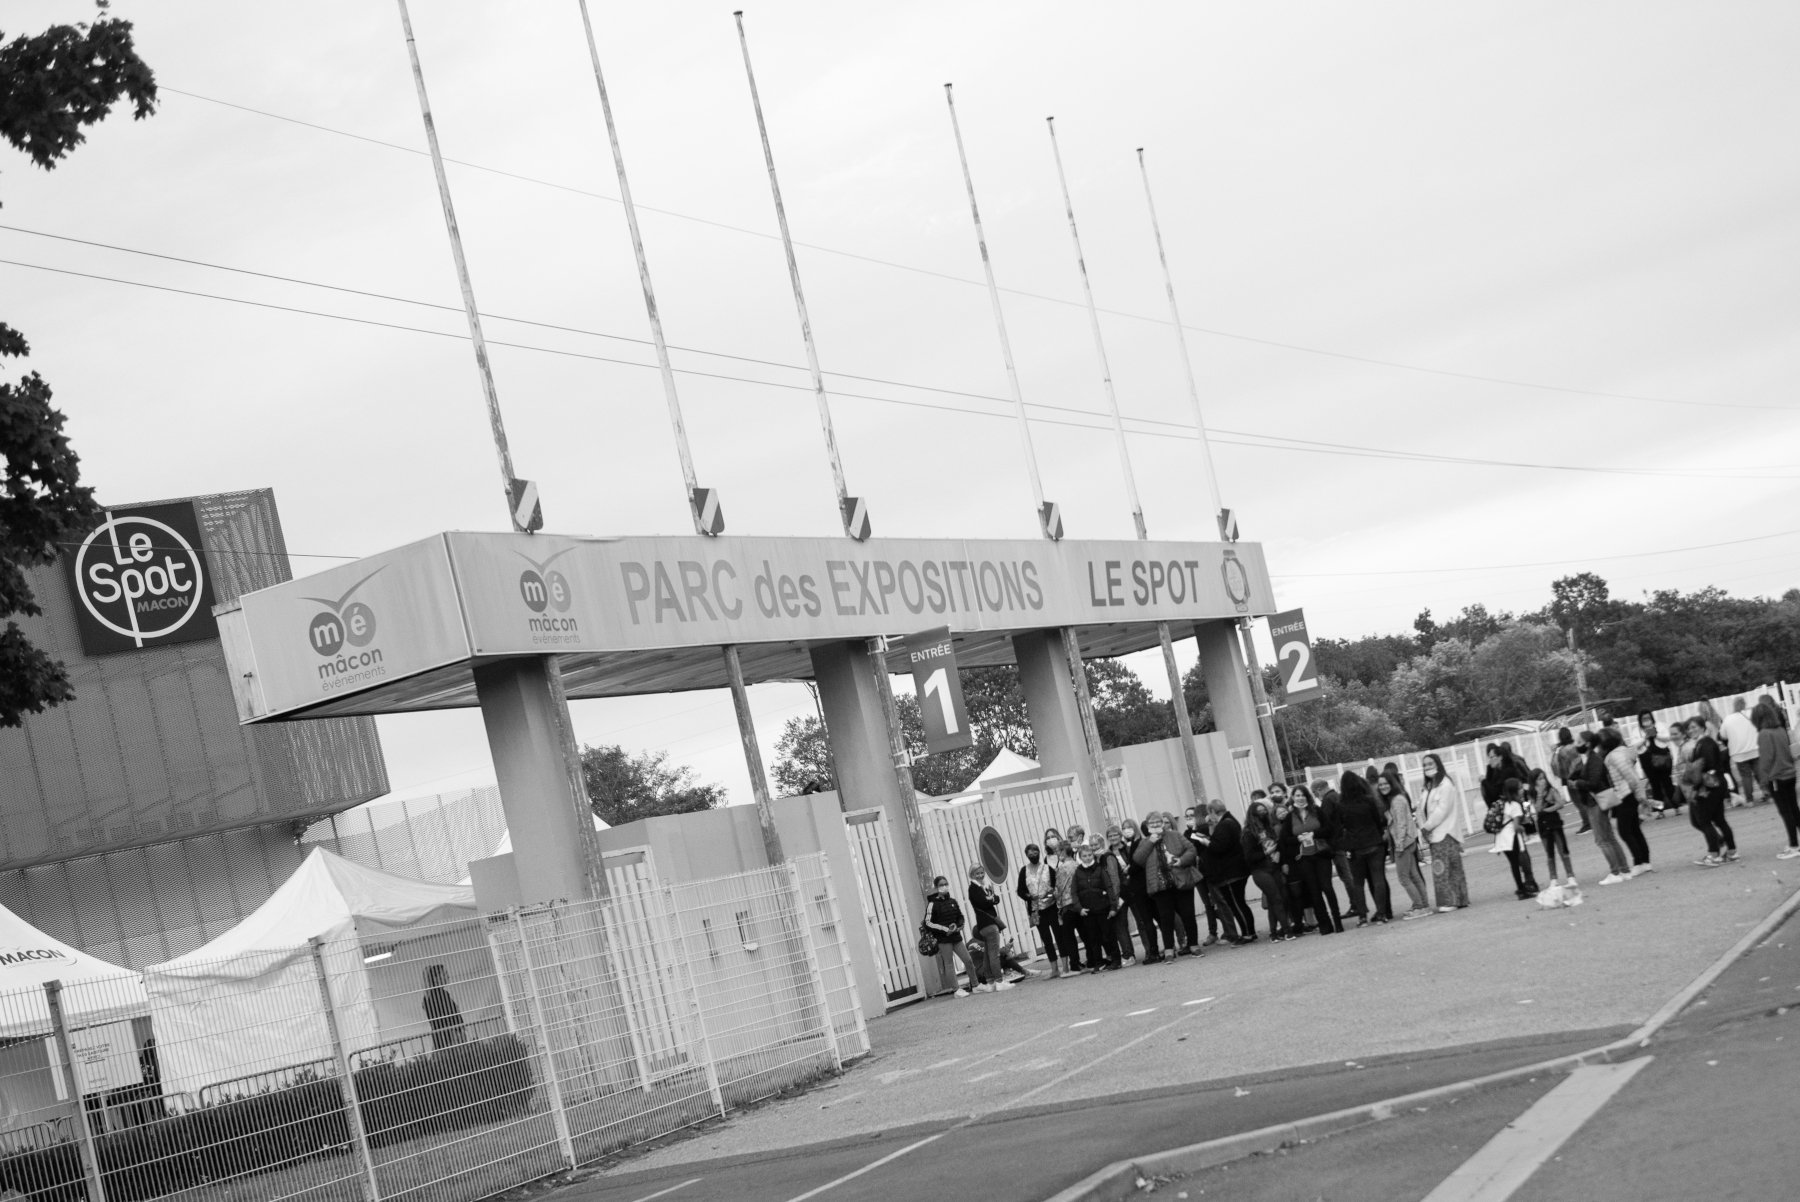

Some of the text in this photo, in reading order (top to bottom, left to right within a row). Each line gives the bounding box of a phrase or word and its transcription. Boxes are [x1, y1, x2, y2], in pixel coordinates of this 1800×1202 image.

[89, 555, 193, 648] Spot
[137, 595, 189, 613] MACON
[619, 559, 1199, 625] PARC des EXPOSITIONS LE SPOT
[528, 613, 578, 631] mâcon
[1271, 621, 1305, 637] ENTRÉE
[318, 648, 383, 679] mâcon
[910, 643, 952, 663] ENTRÉE
[1279, 640, 1318, 694] 2
[923, 667, 959, 735] 1
[0, 949, 66, 966] MACON
